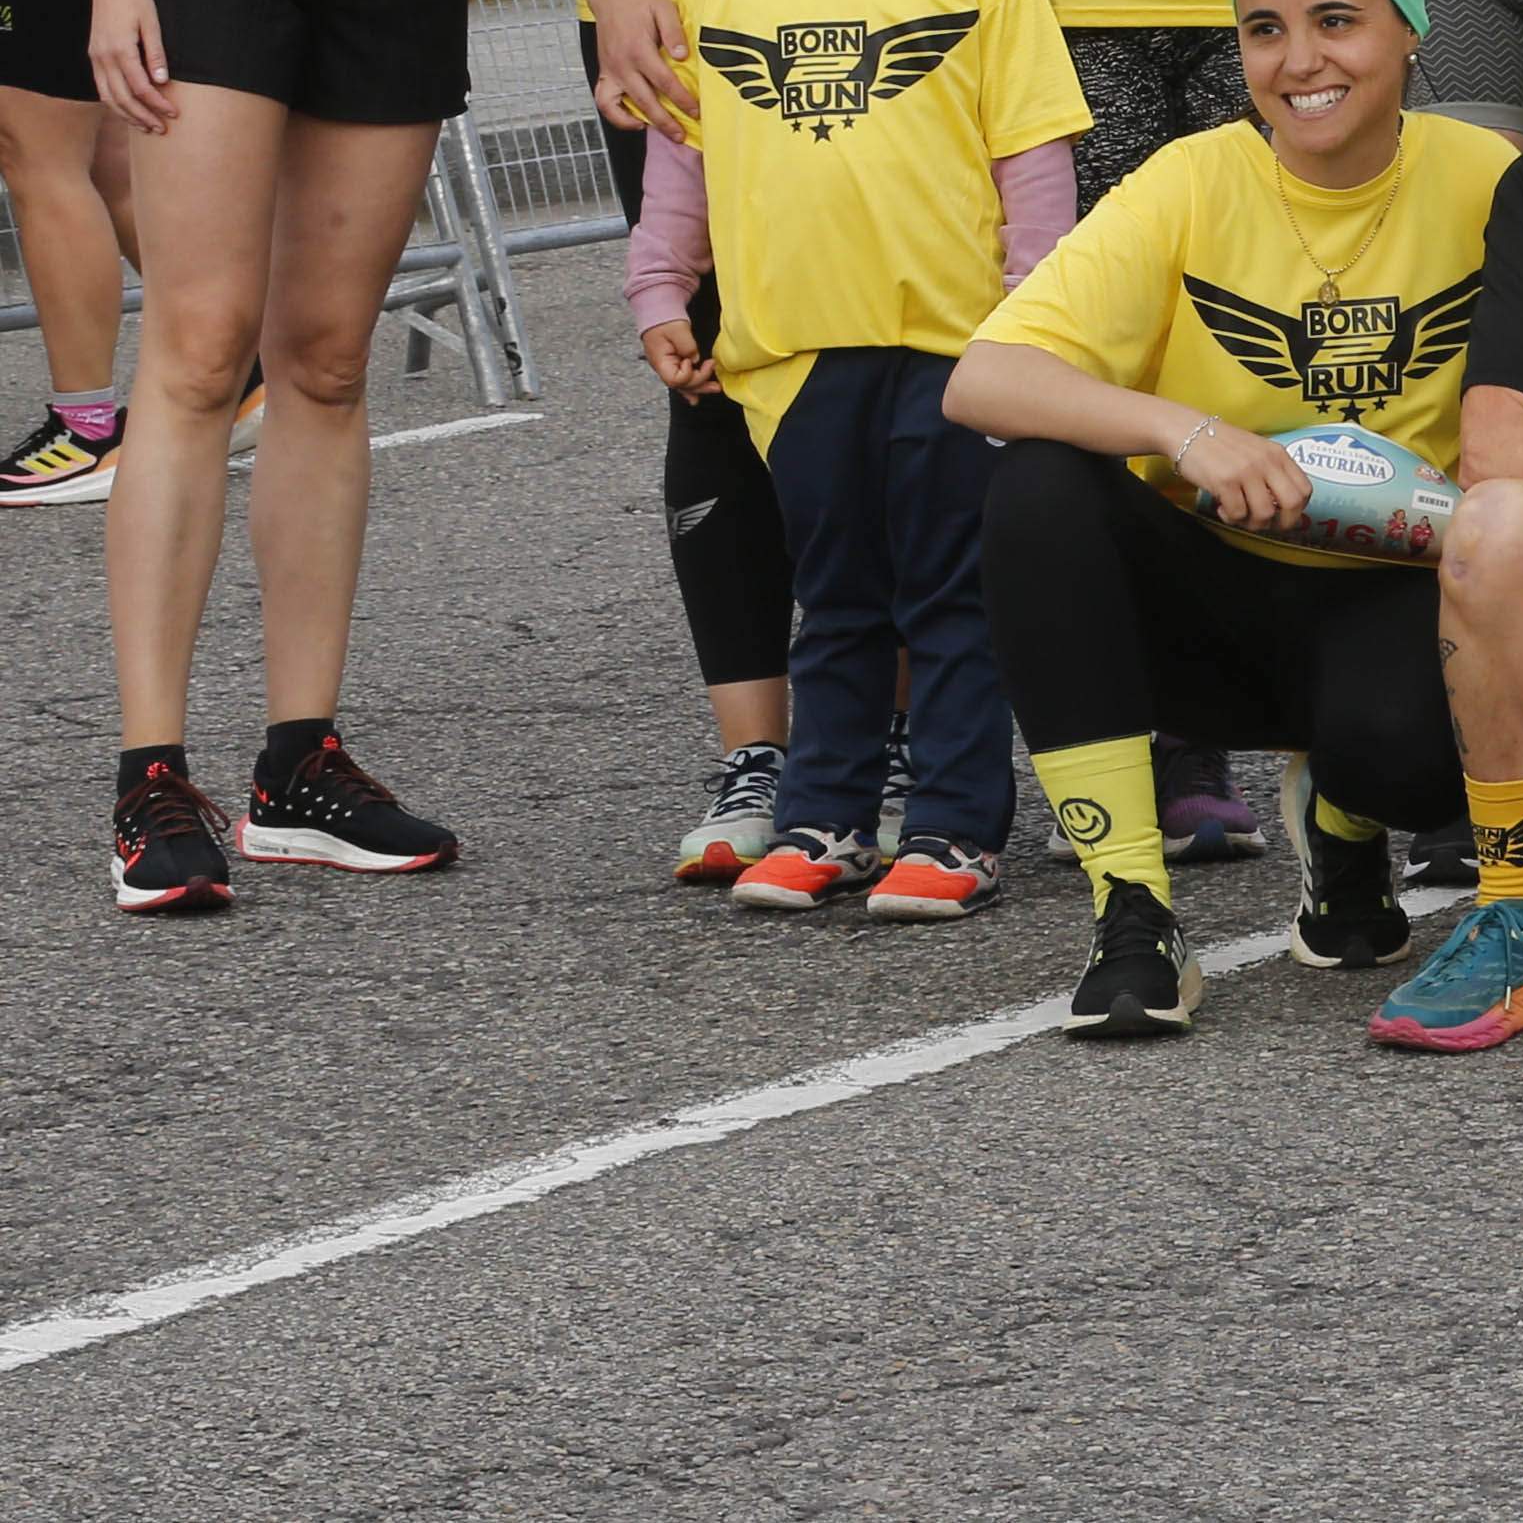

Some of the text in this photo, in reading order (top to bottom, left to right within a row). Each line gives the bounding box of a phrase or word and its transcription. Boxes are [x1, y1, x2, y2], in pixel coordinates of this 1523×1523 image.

[783, 27, 861, 57] BORN
[785, 84, 862, 112] RUN
[1310, 304, 1394, 336] BORN
[1311, 363, 1397, 394] RUN
[1293, 447, 1387, 479] ASTURIANA
